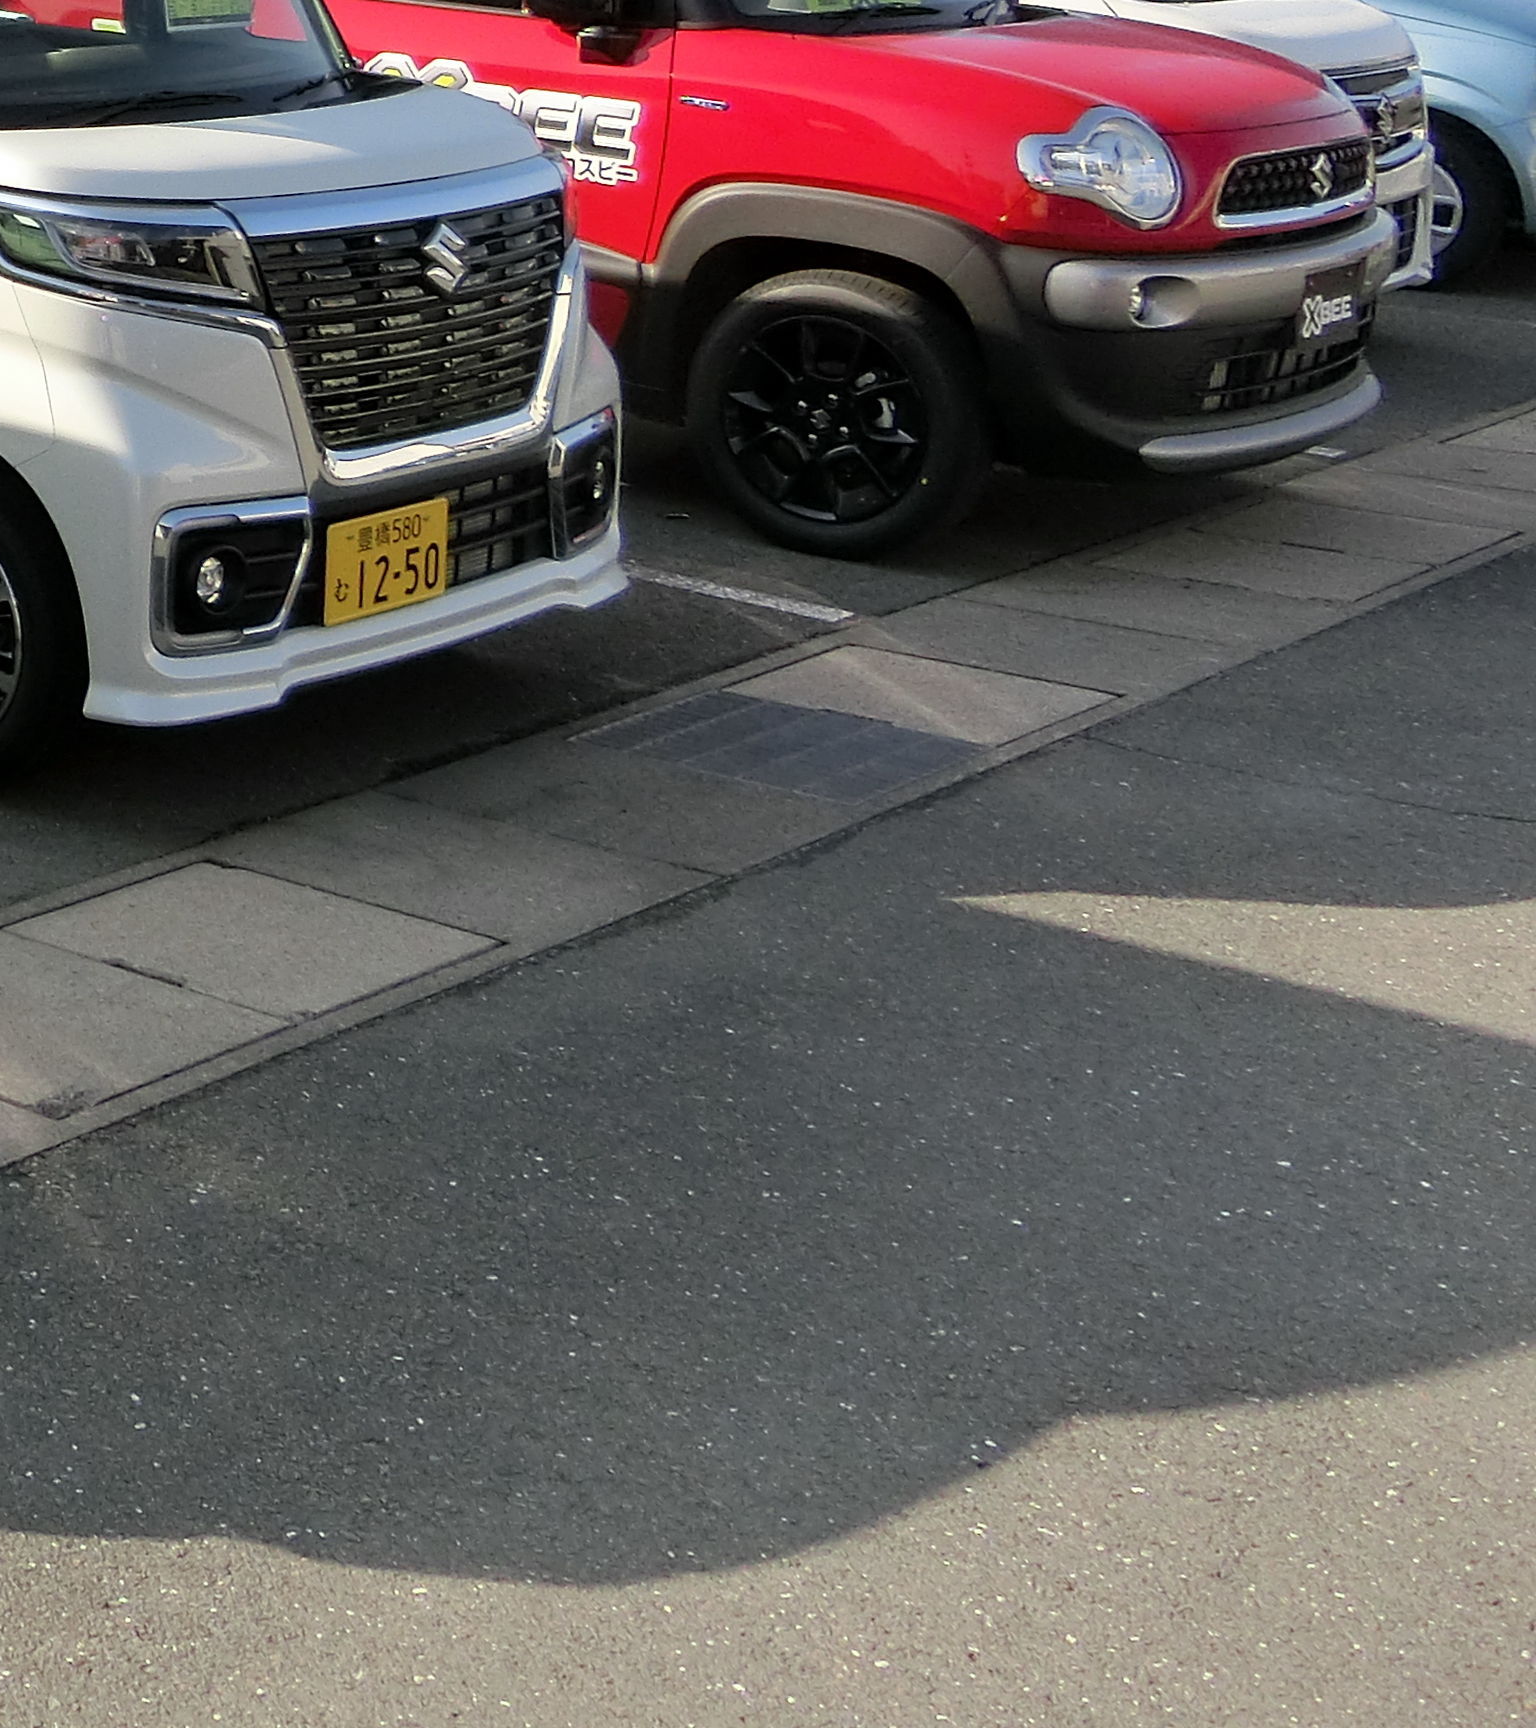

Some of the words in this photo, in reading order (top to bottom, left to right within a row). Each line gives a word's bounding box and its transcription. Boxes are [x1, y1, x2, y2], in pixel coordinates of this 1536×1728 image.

[1302, 295, 1352, 338] XBEE
[335, 578, 349, 602] む
[358, 542, 439, 608] 12-50
